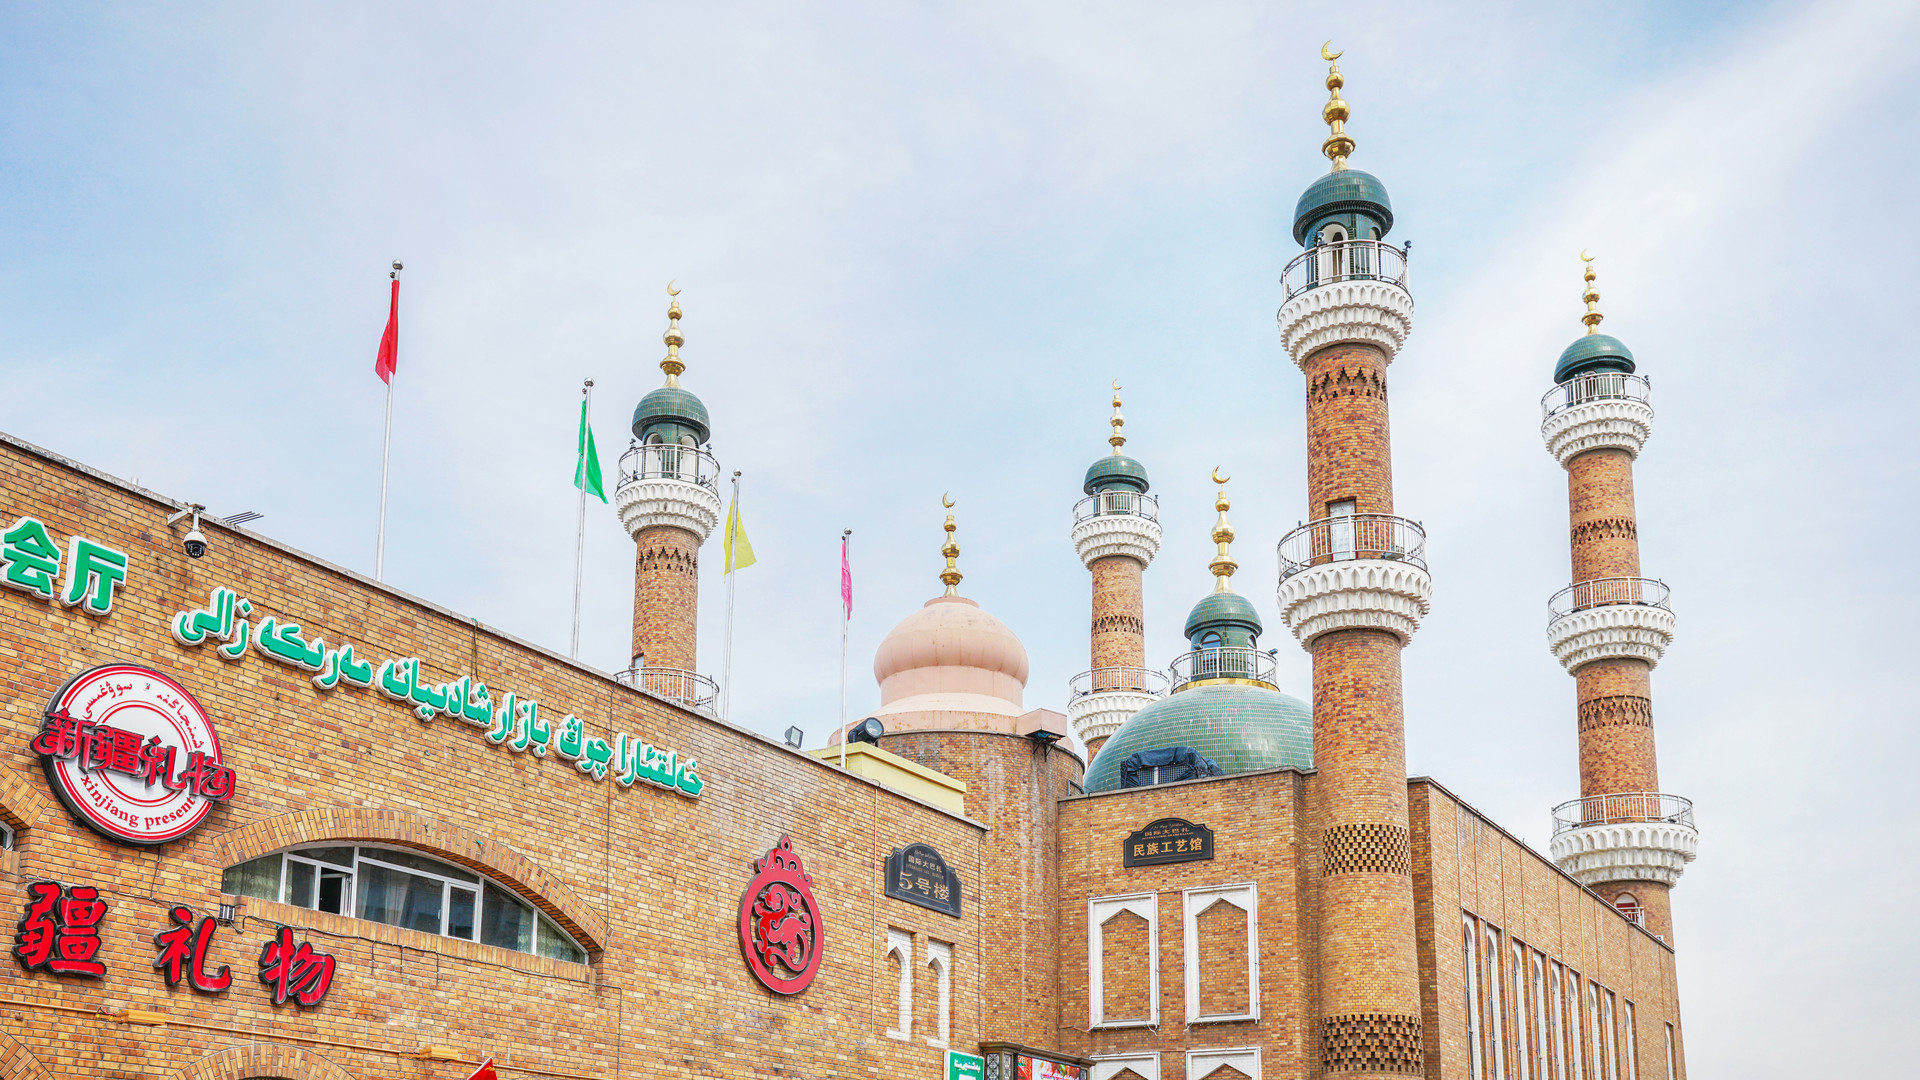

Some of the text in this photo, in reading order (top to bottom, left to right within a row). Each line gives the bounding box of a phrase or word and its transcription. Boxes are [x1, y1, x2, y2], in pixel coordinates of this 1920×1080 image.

[1, 516, 129, 616] 会厅
[31, 706, 236, 802] 新疆礼物
[484, 692, 551, 759] بازار
[80, 774, 196, 830] xinjiang present
[907, 855, 943, 873] 国际大巴扎
[1133, 837, 1203, 857] 民族工艺馆
[899, 872, 950, 902] 5号楼
[11, 879, 336, 1006] 疆礼物
